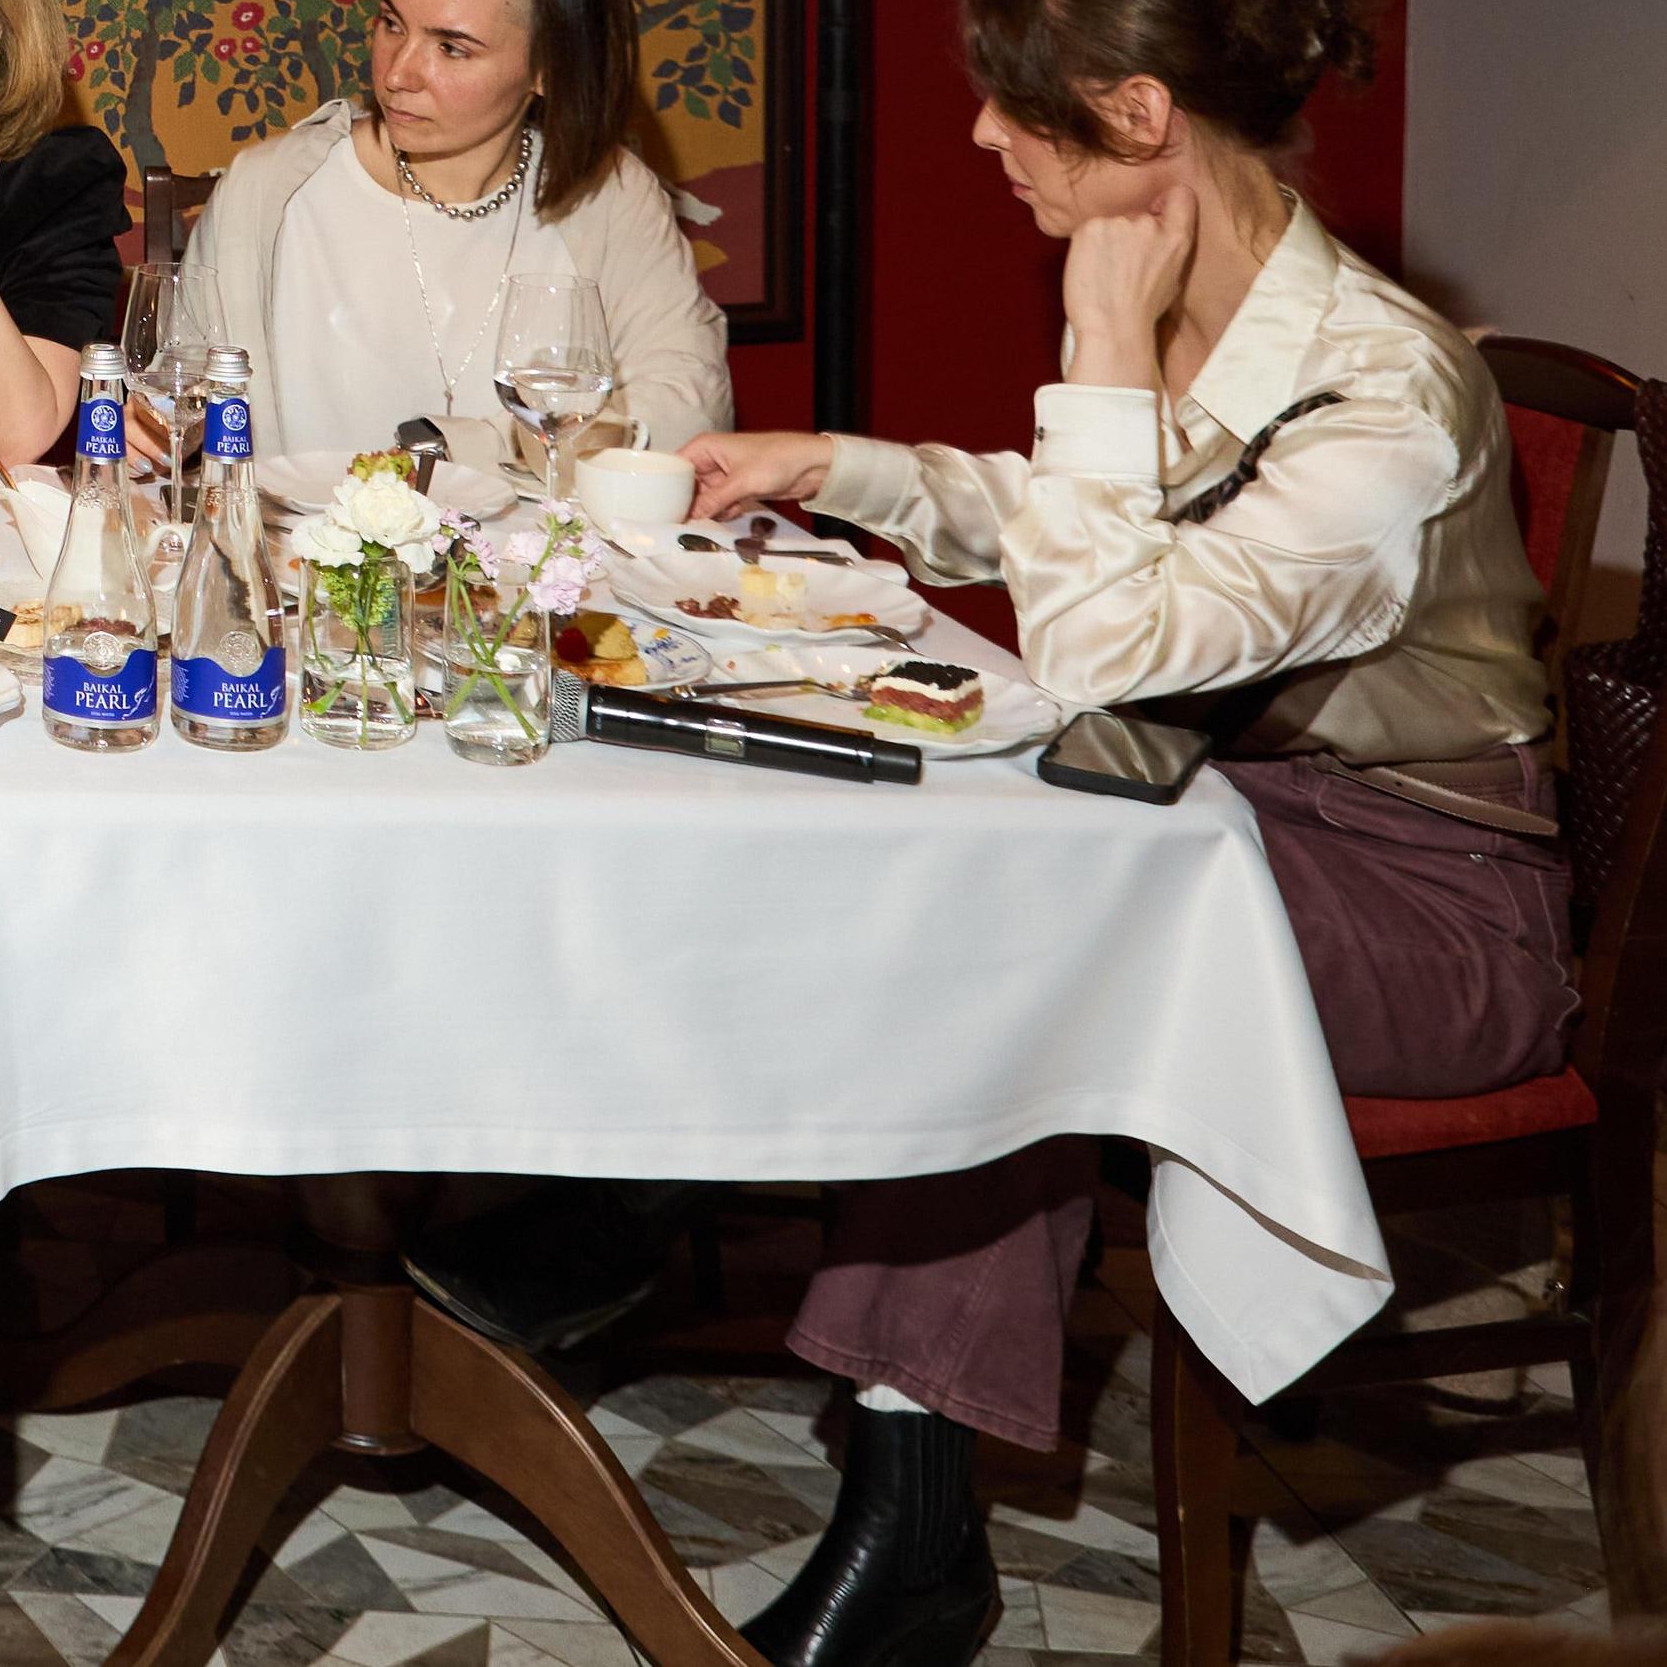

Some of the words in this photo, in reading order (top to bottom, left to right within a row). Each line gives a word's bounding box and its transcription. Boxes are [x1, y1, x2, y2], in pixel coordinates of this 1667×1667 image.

[85, 441, 122, 455] PEARL
[217, 441, 251, 454] PEARL
[83, 682, 123, 694] BAIKAL
[221, 682, 261, 693] BAIKAL
[75, 690, 131, 710] PEARL
[213, 691, 268, 709] PEARL
